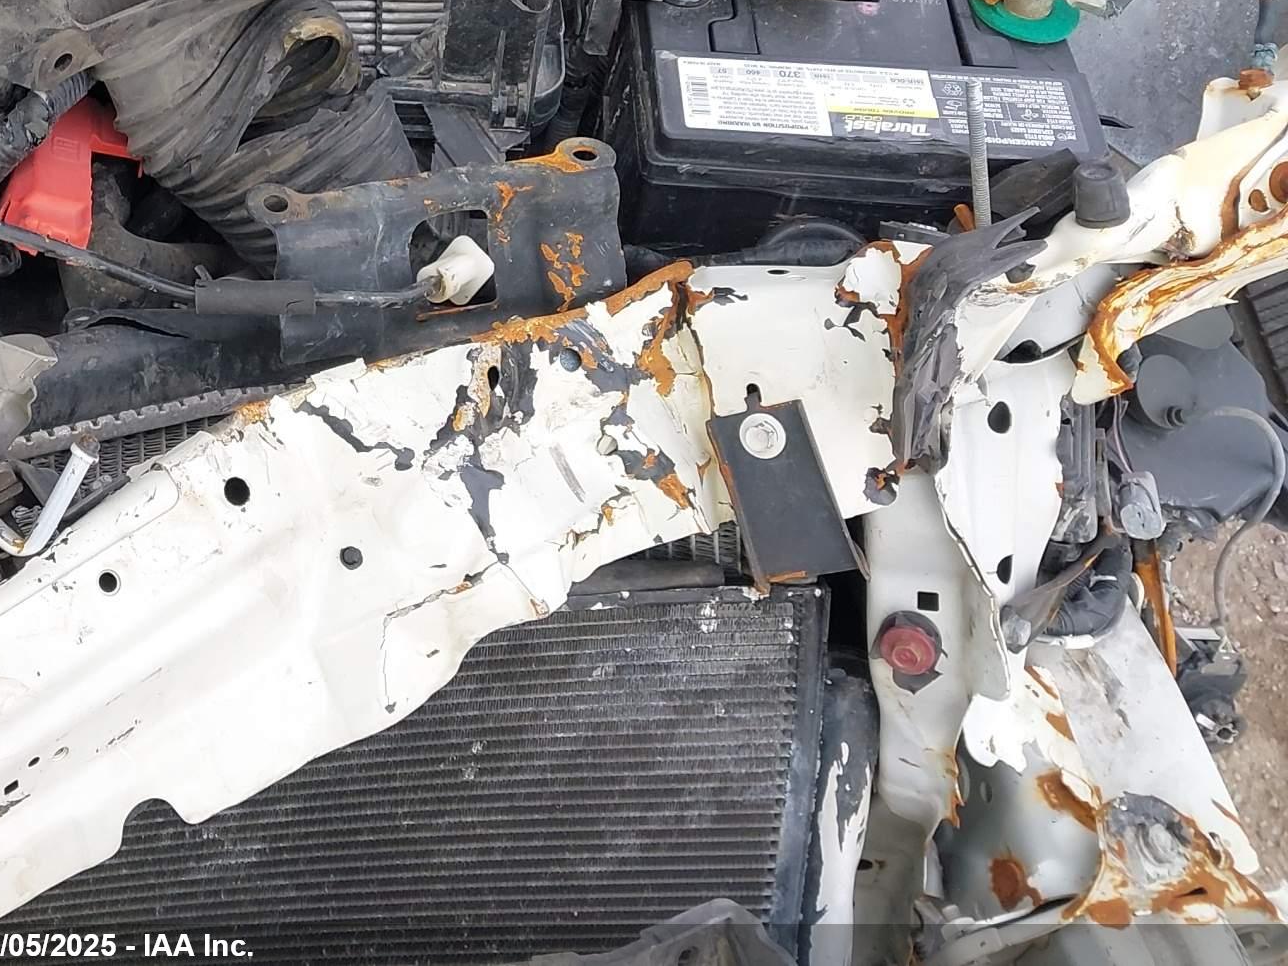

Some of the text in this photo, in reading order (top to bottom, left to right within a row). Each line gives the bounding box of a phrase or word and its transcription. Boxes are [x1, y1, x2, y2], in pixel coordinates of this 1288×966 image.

[778, 70, 802, 79] 370
[845, 114, 883, 122] GOLD
[843, 120, 931, 137] Duralast
